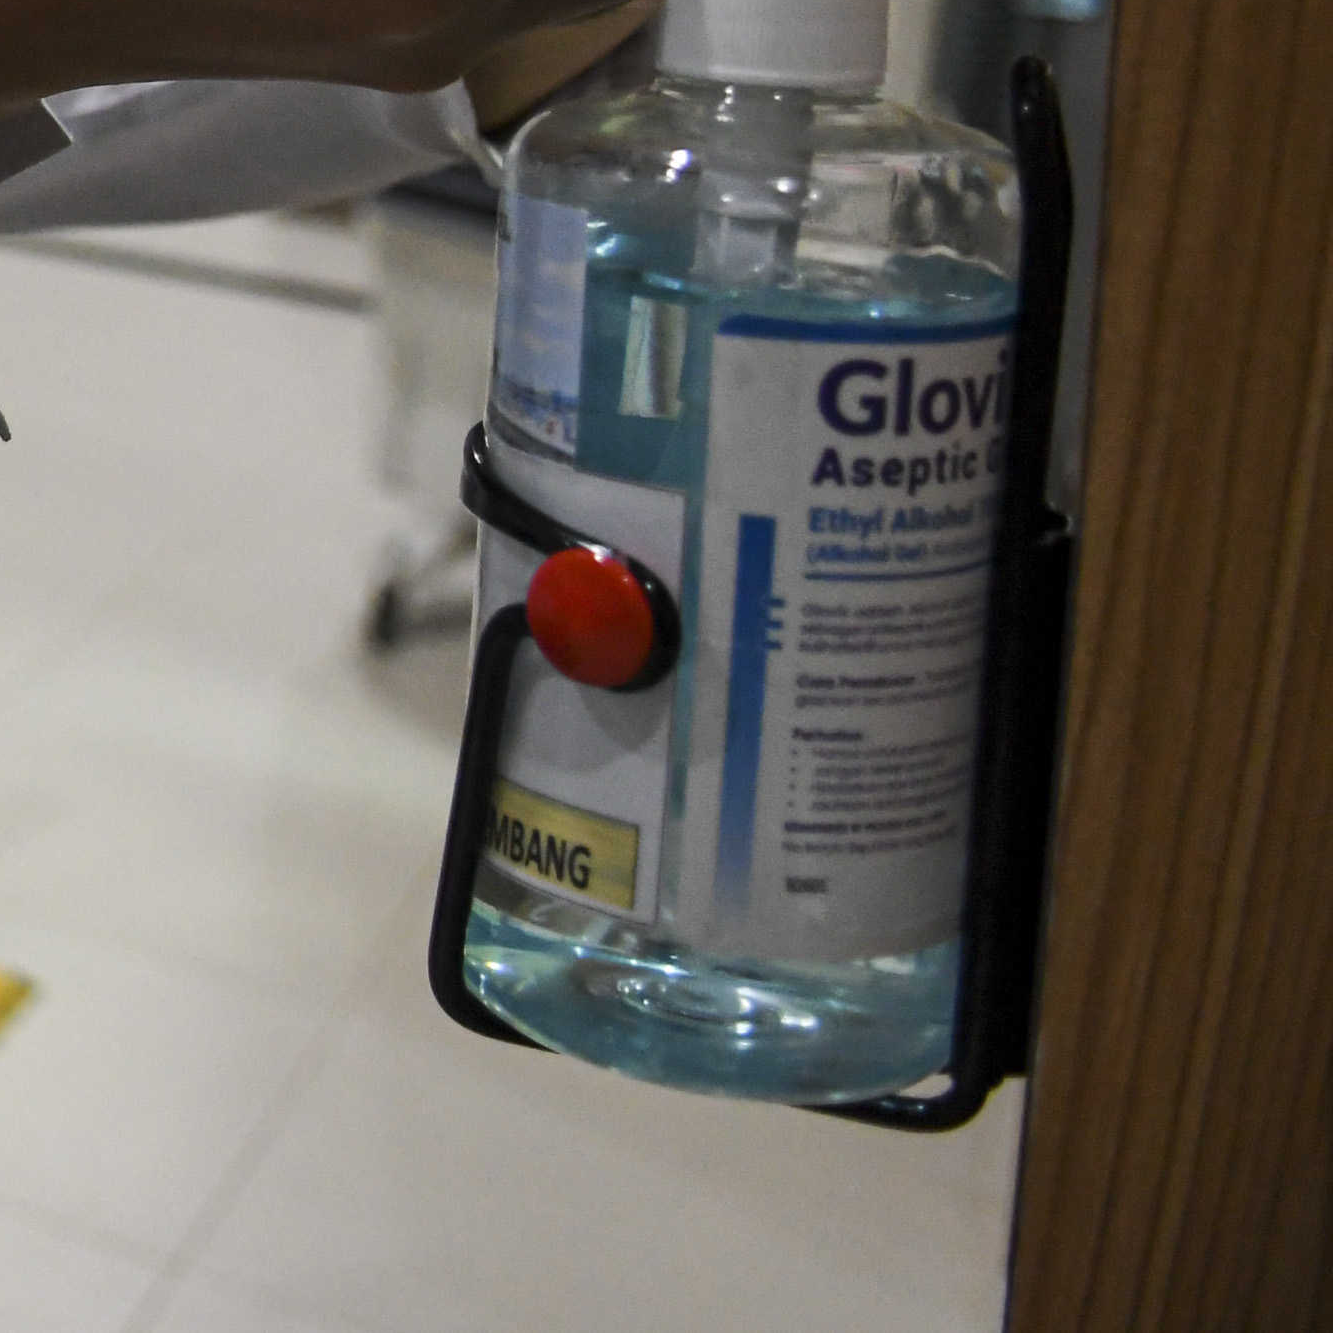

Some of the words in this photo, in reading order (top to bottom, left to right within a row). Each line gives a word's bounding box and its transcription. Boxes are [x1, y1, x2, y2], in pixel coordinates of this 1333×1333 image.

[812, 442, 978, 495] Aseptic
[808, 506, 883, 538] Ethyl
[490, 809, 591, 888] MBANG
